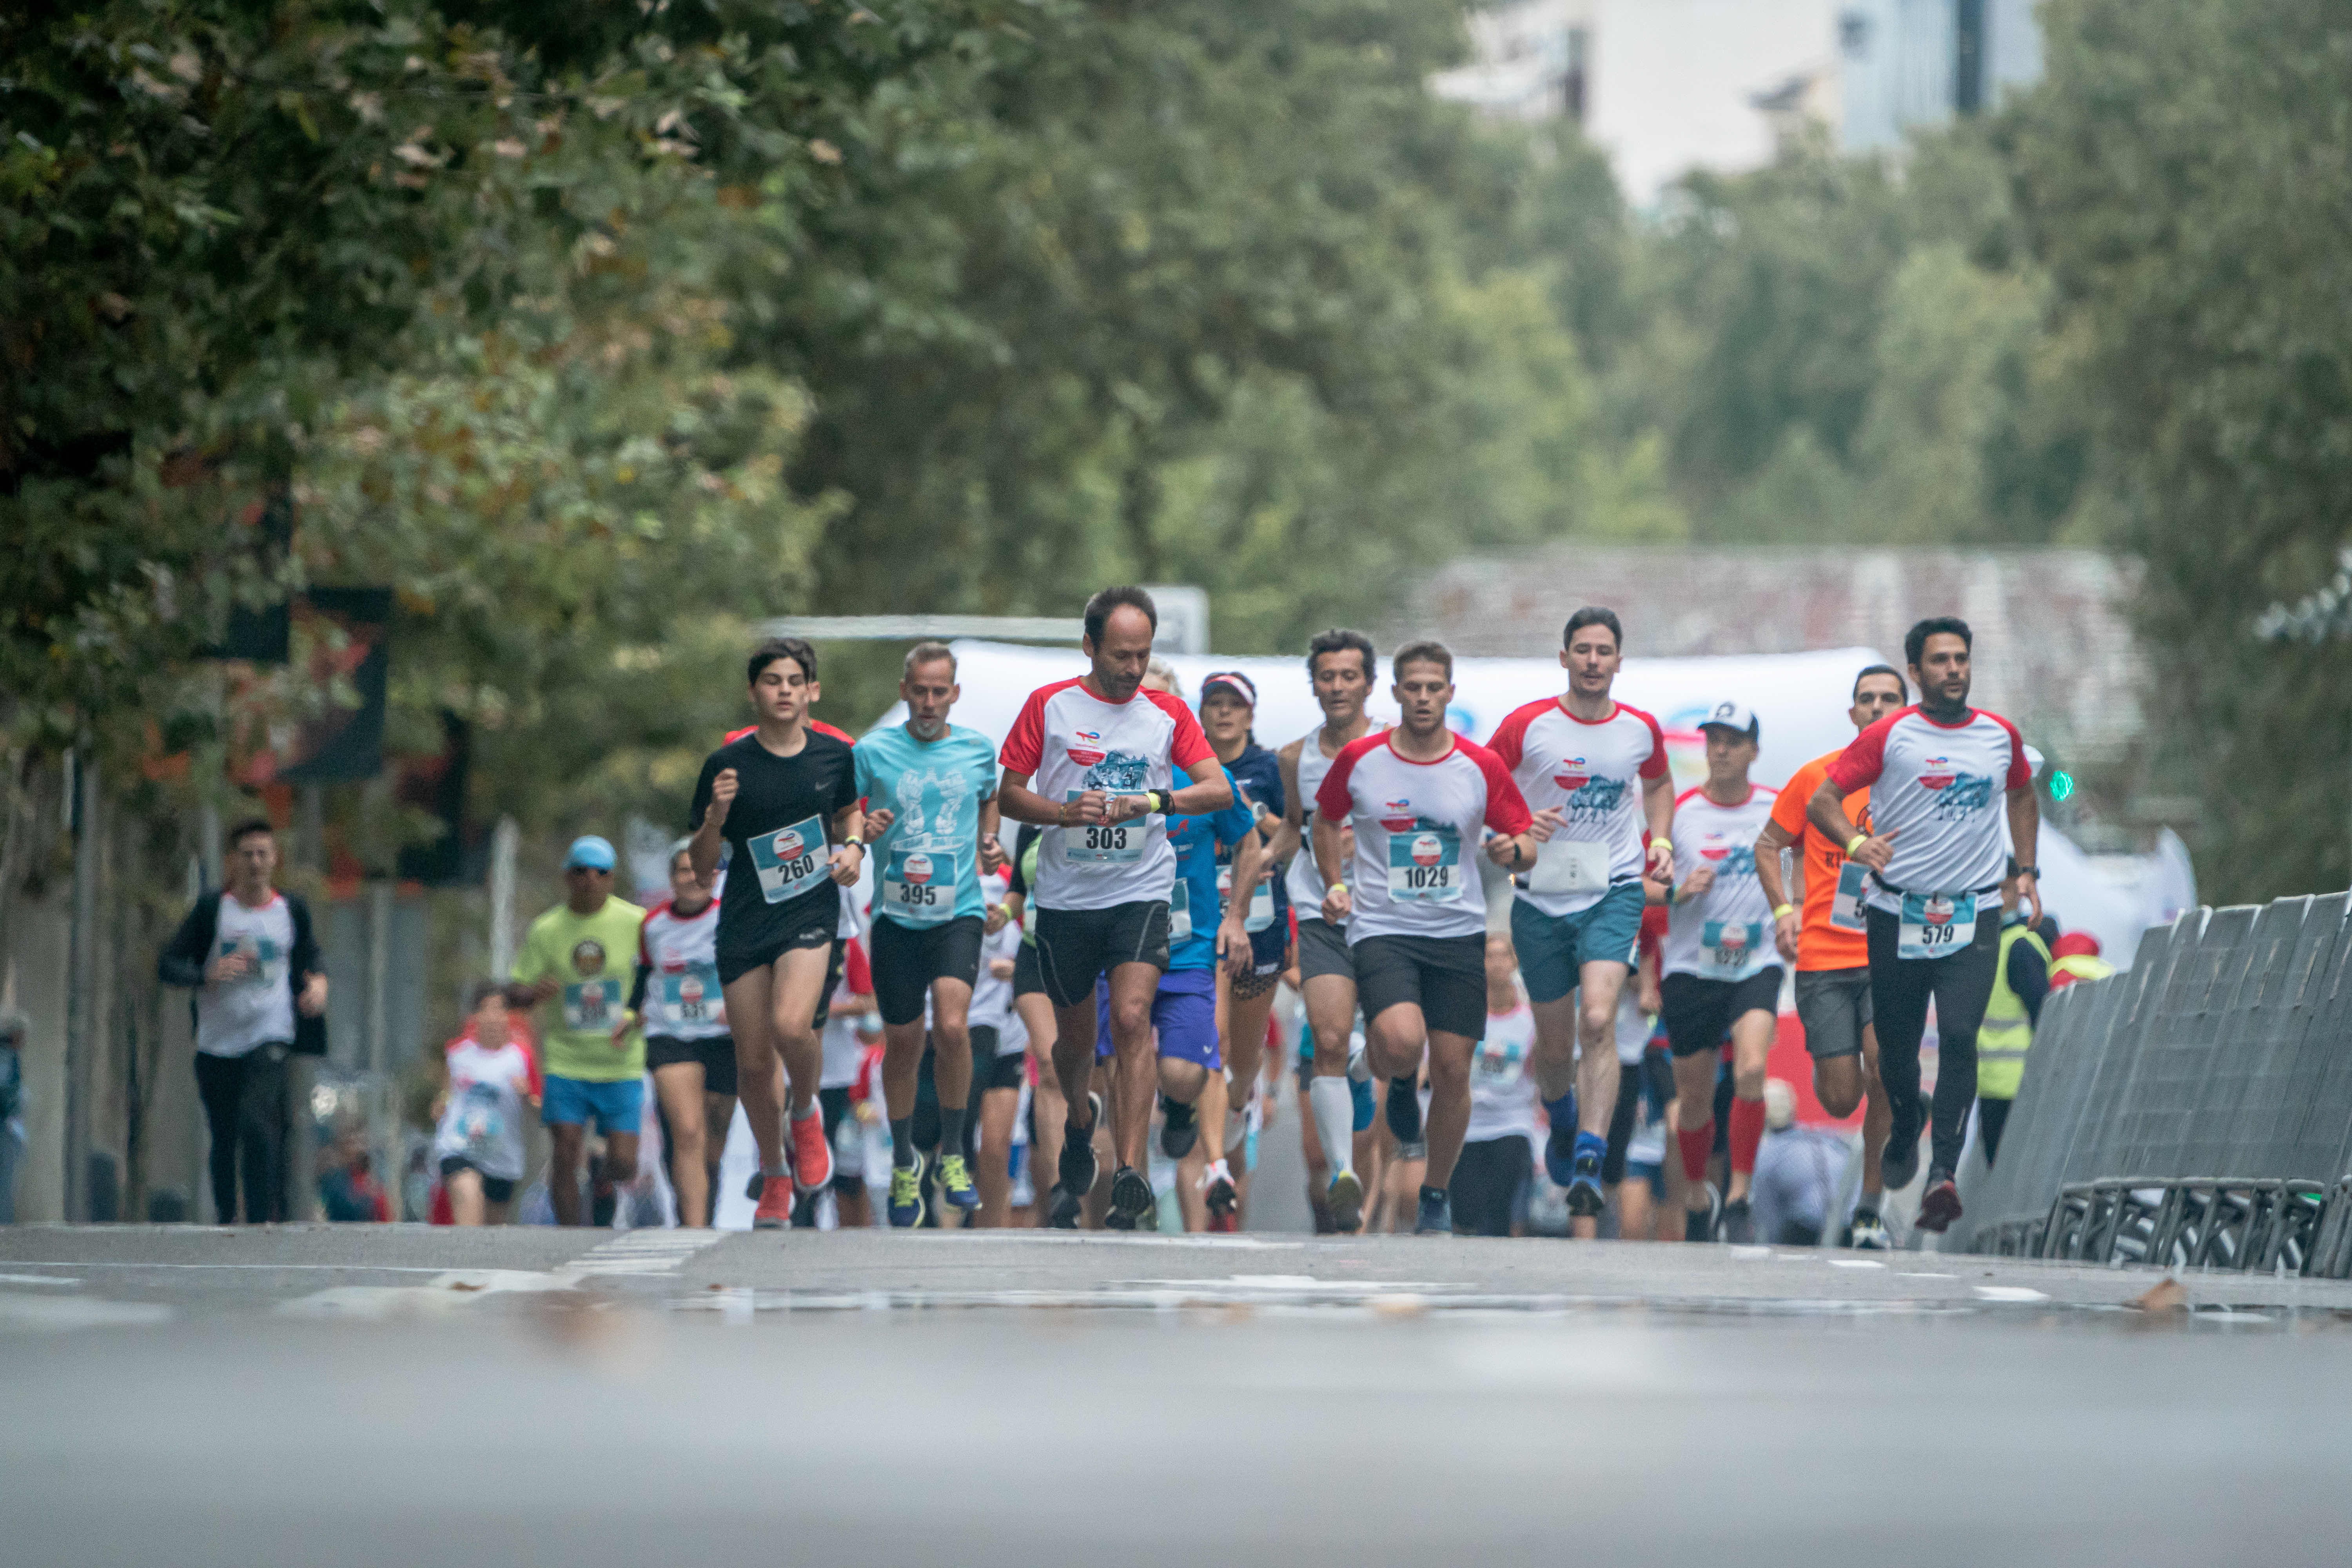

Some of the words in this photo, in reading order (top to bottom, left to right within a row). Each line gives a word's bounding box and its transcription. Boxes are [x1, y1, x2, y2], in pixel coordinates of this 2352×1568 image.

[1086, 828, 1127, 849] 303
[778, 855, 814, 884] 260
[1405, 866, 1448, 888] 1029
[900, 884, 936, 906] 395
[1923, 926, 1954, 944] 579
